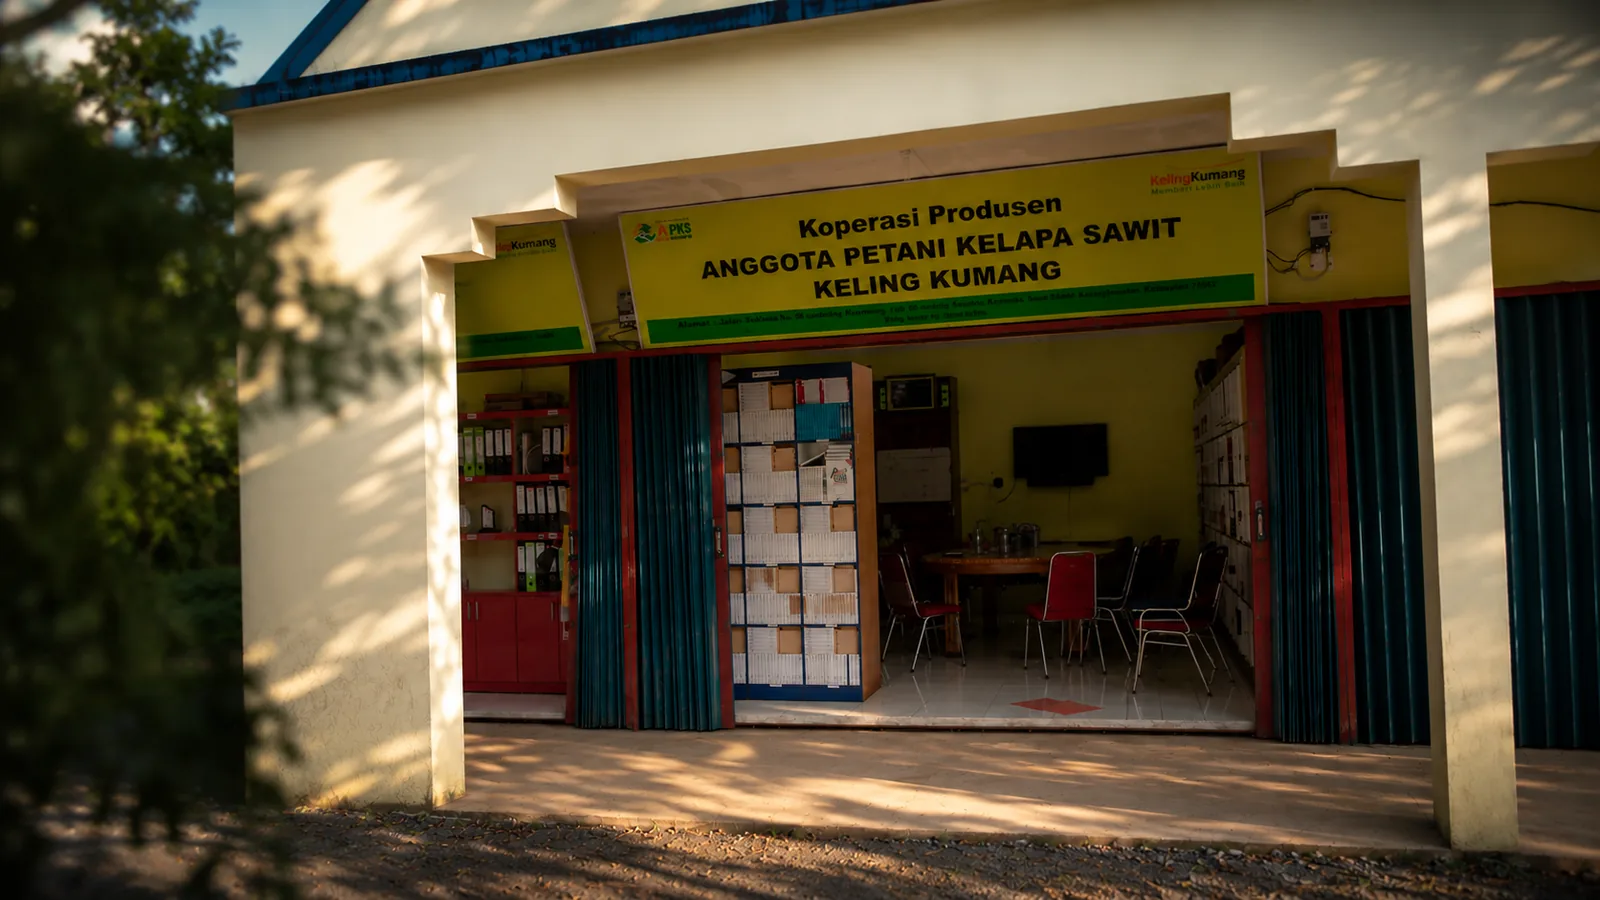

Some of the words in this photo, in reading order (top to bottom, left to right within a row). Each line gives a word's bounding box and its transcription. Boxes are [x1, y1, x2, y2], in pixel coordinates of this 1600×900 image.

[799, 213, 920, 241] Koperasi
[928, 197, 1062, 226] Produsen
[701, 247, 836, 280] ANGGOTA
[843, 238, 946, 267] PETANI
[956, 226, 1074, 257] KELAPA
[1082, 216, 1182, 245] SAWIT
[813, 272, 920, 299] KELING
[929, 260, 1062, 290] KUMANG
